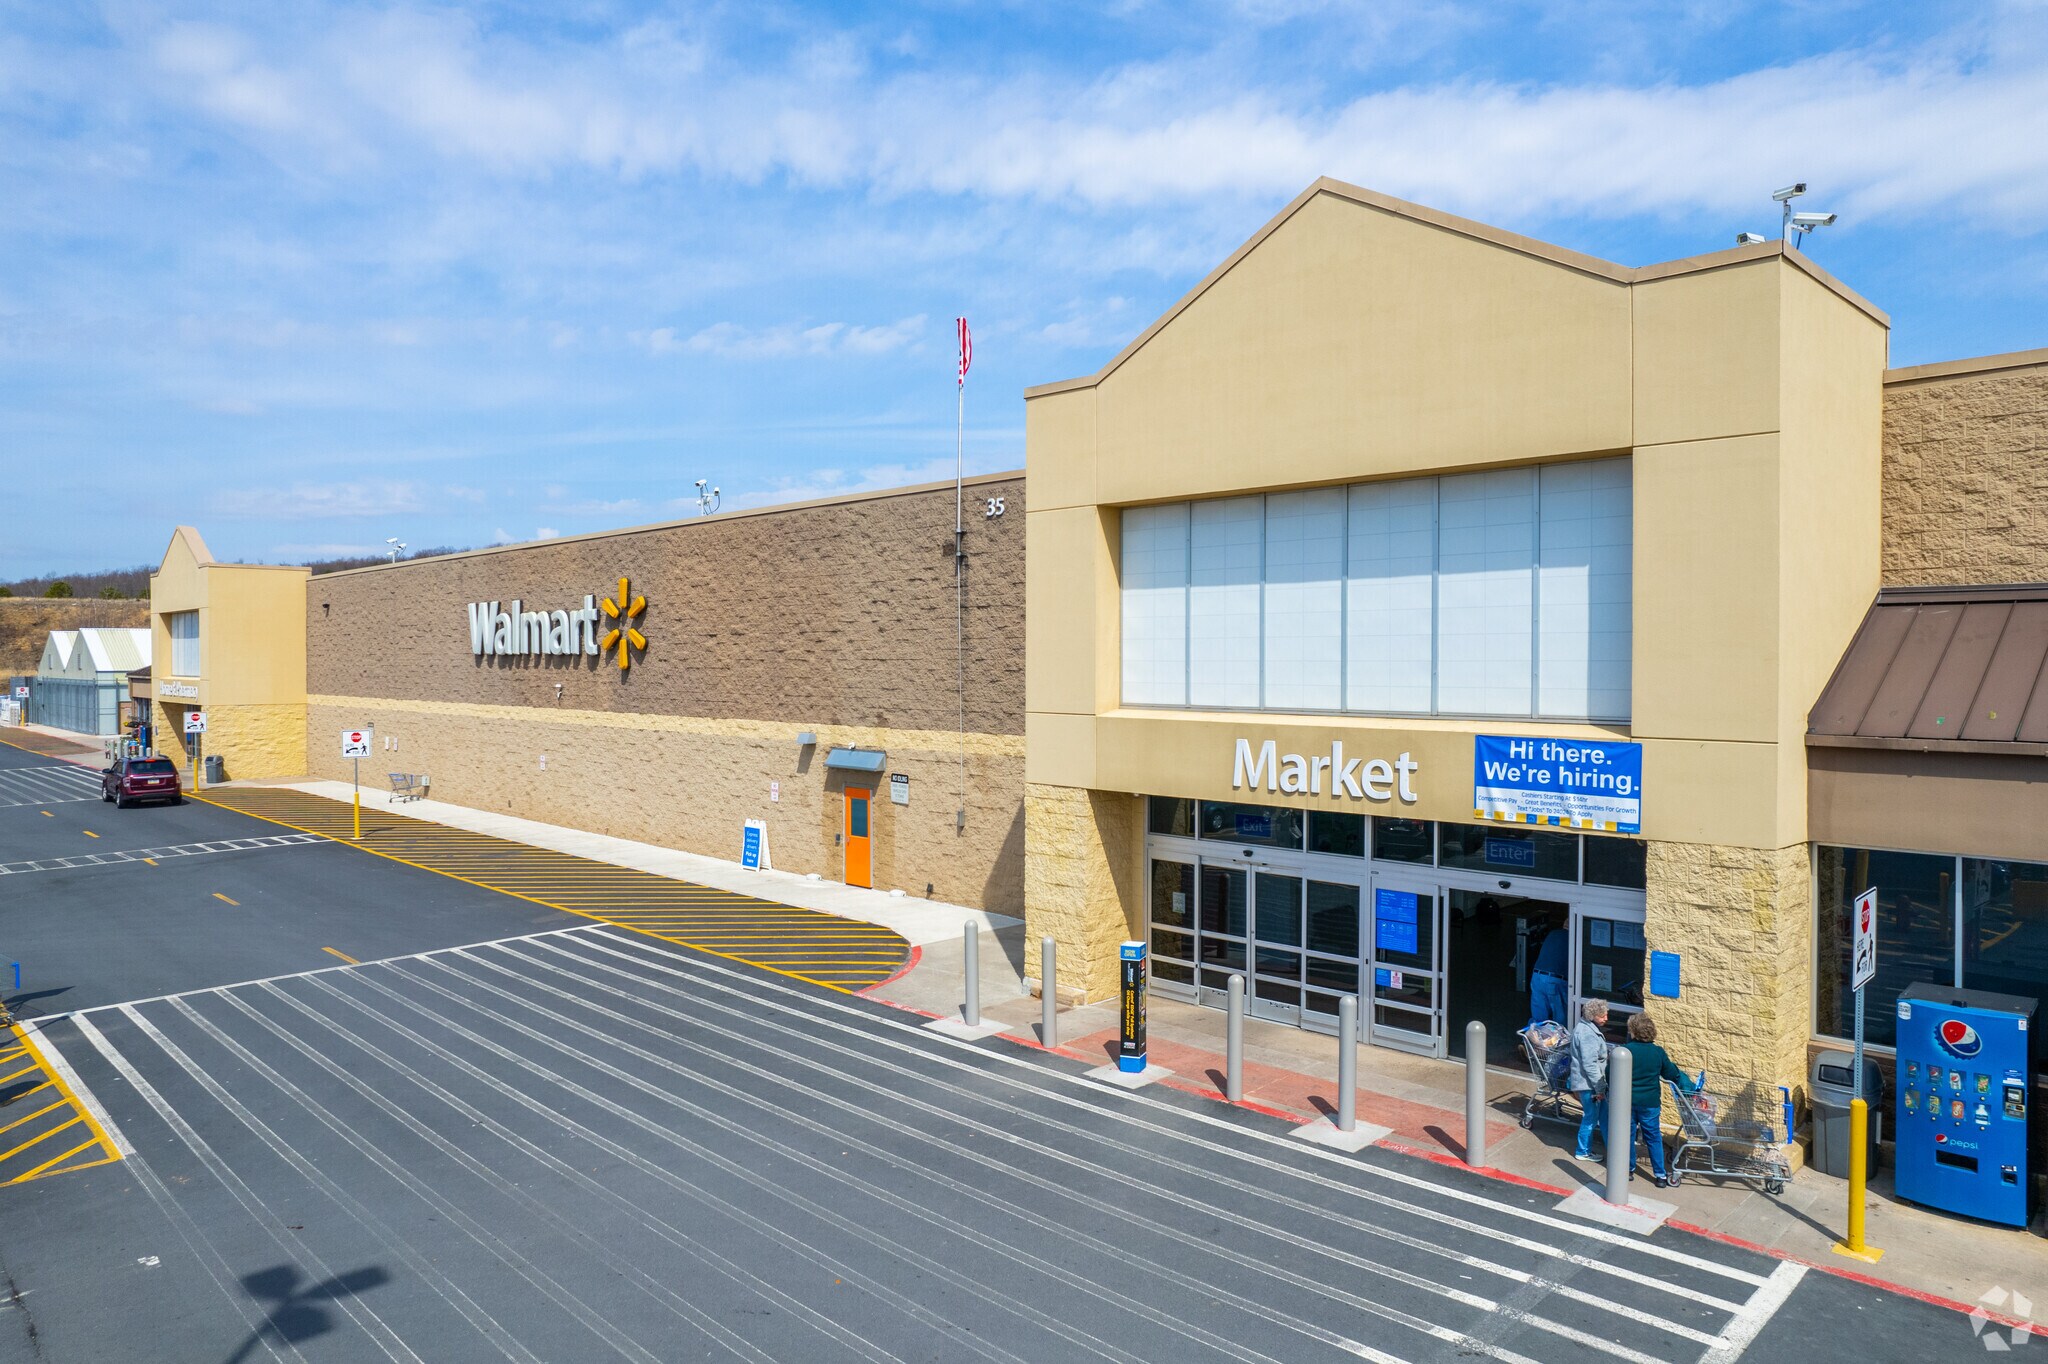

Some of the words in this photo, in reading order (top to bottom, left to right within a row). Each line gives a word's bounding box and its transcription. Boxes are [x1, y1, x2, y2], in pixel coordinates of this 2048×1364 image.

[986, 497, 1005, 516] 35
[467, 594, 598, 656] Walmart
[1509, 740, 1533, 760] Hi
[1541, 742, 1612, 765] there.
[1232, 739, 1418, 802] Market
[1483, 761, 1551, 784] We're
[1558, 766, 1639, 795] hiring.
[1478, 795, 1507, 803] Competitive
[1567, 803, 1604, 811] Opportunities
[1544, 793, 1565, 801] Starting
[1243, 818, 1263, 833] Exit
[1490, 844, 1529, 861] Enter
[1949, 1139, 1978, 1150] pepsi
